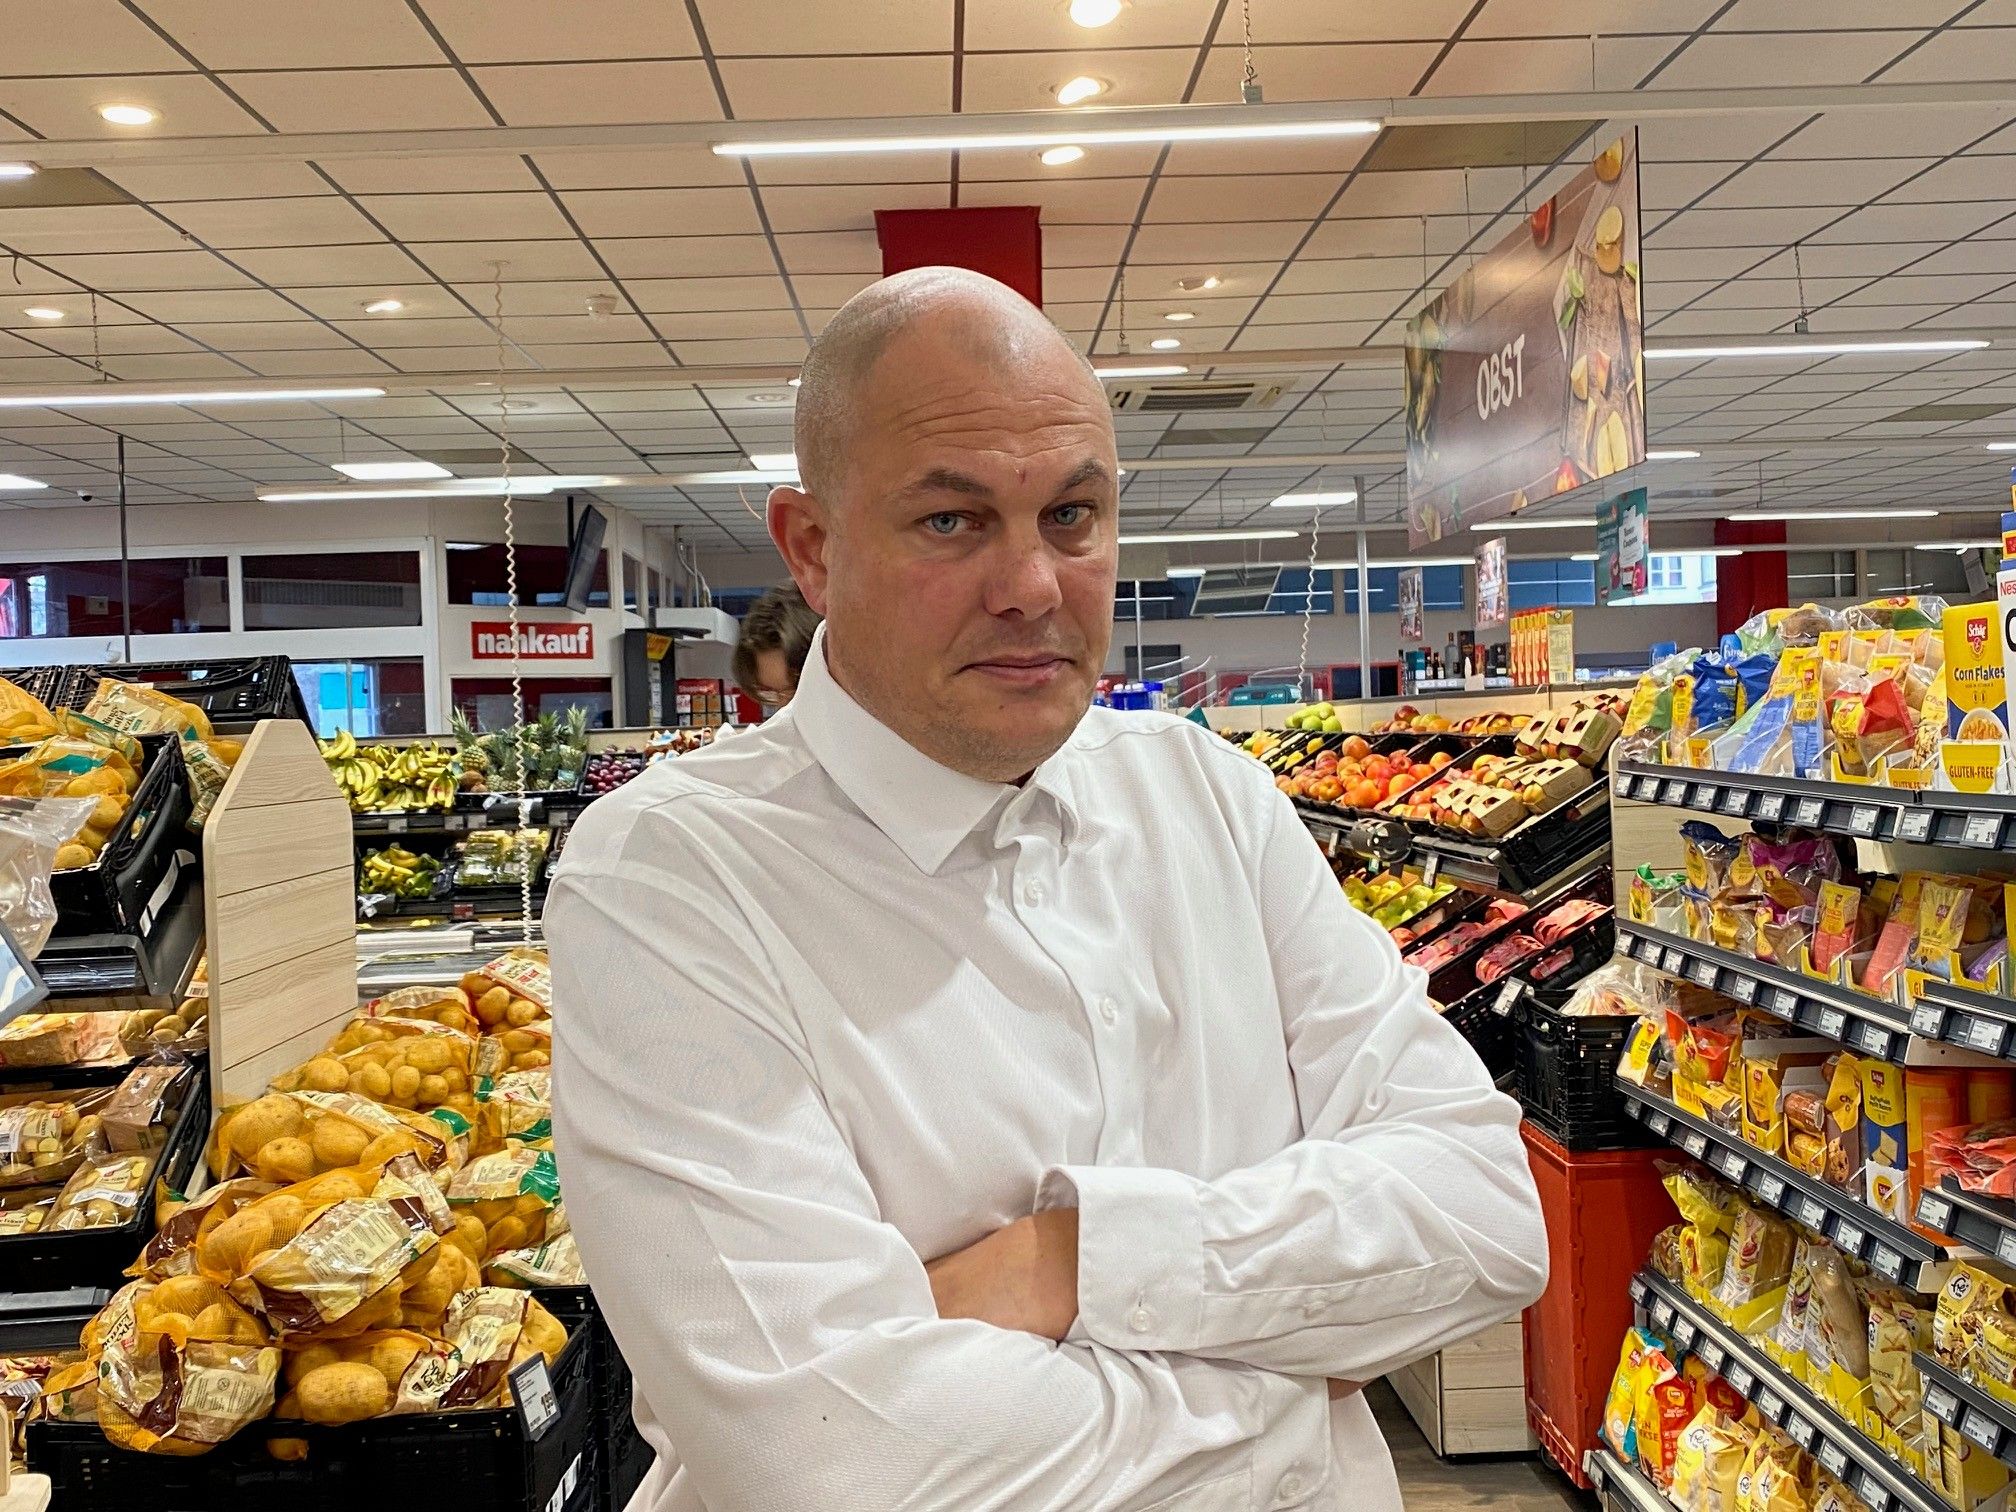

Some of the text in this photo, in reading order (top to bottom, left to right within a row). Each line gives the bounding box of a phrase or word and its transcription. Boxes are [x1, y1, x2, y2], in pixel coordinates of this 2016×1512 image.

[1477, 334, 1525, 420] OBST
[1953, 664, 2005, 681] Corn Flakes
[1949, 764, 1994, 780] GLUTEN-FREE
